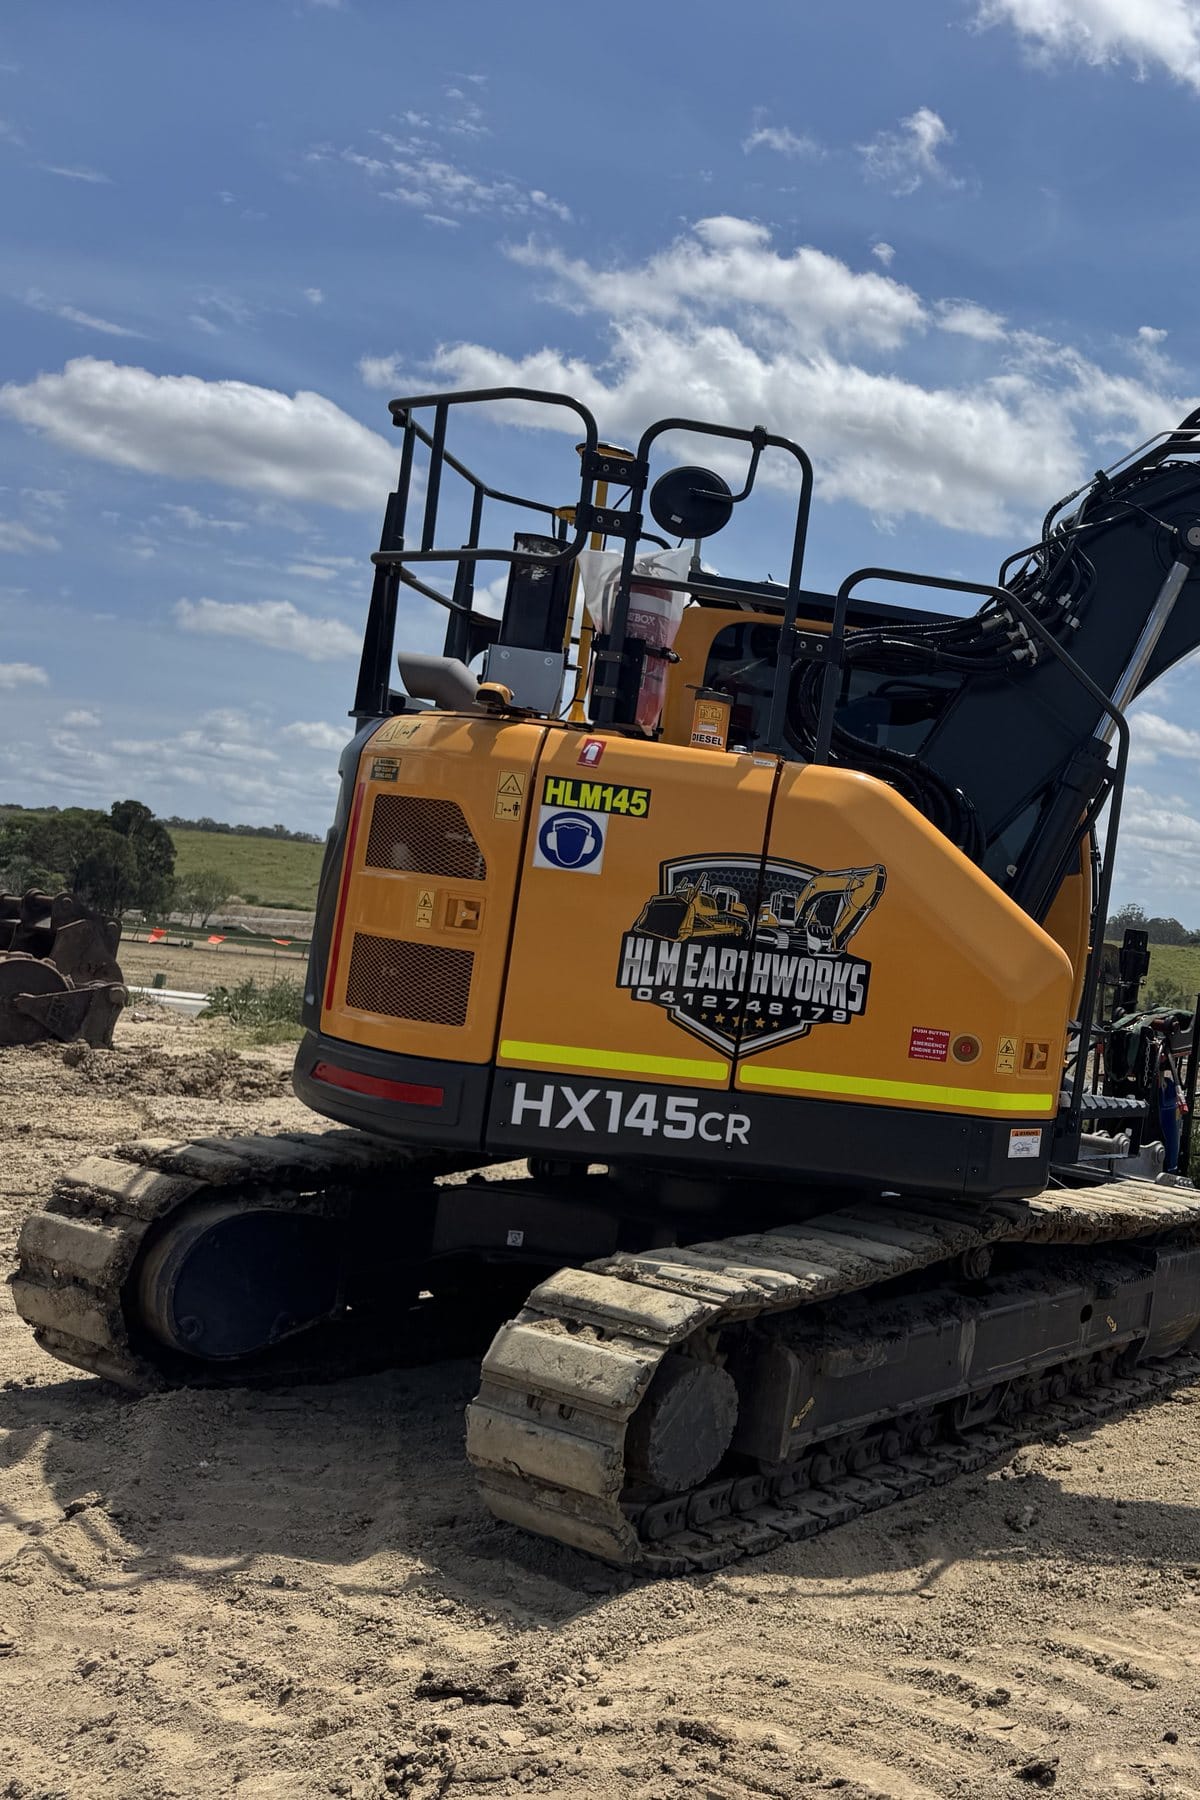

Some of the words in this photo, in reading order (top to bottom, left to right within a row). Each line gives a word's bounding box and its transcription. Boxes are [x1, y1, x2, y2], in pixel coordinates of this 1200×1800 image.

[692, 733, 722, 746] DIESEL
[545, 778, 648, 817] HLM145
[620, 937, 683, 988] HLM
[682, 944, 868, 1011] EARTHWORKS
[636, 987, 848, 1023] 0412748179
[511, 1082, 751, 1145] HX145CR
